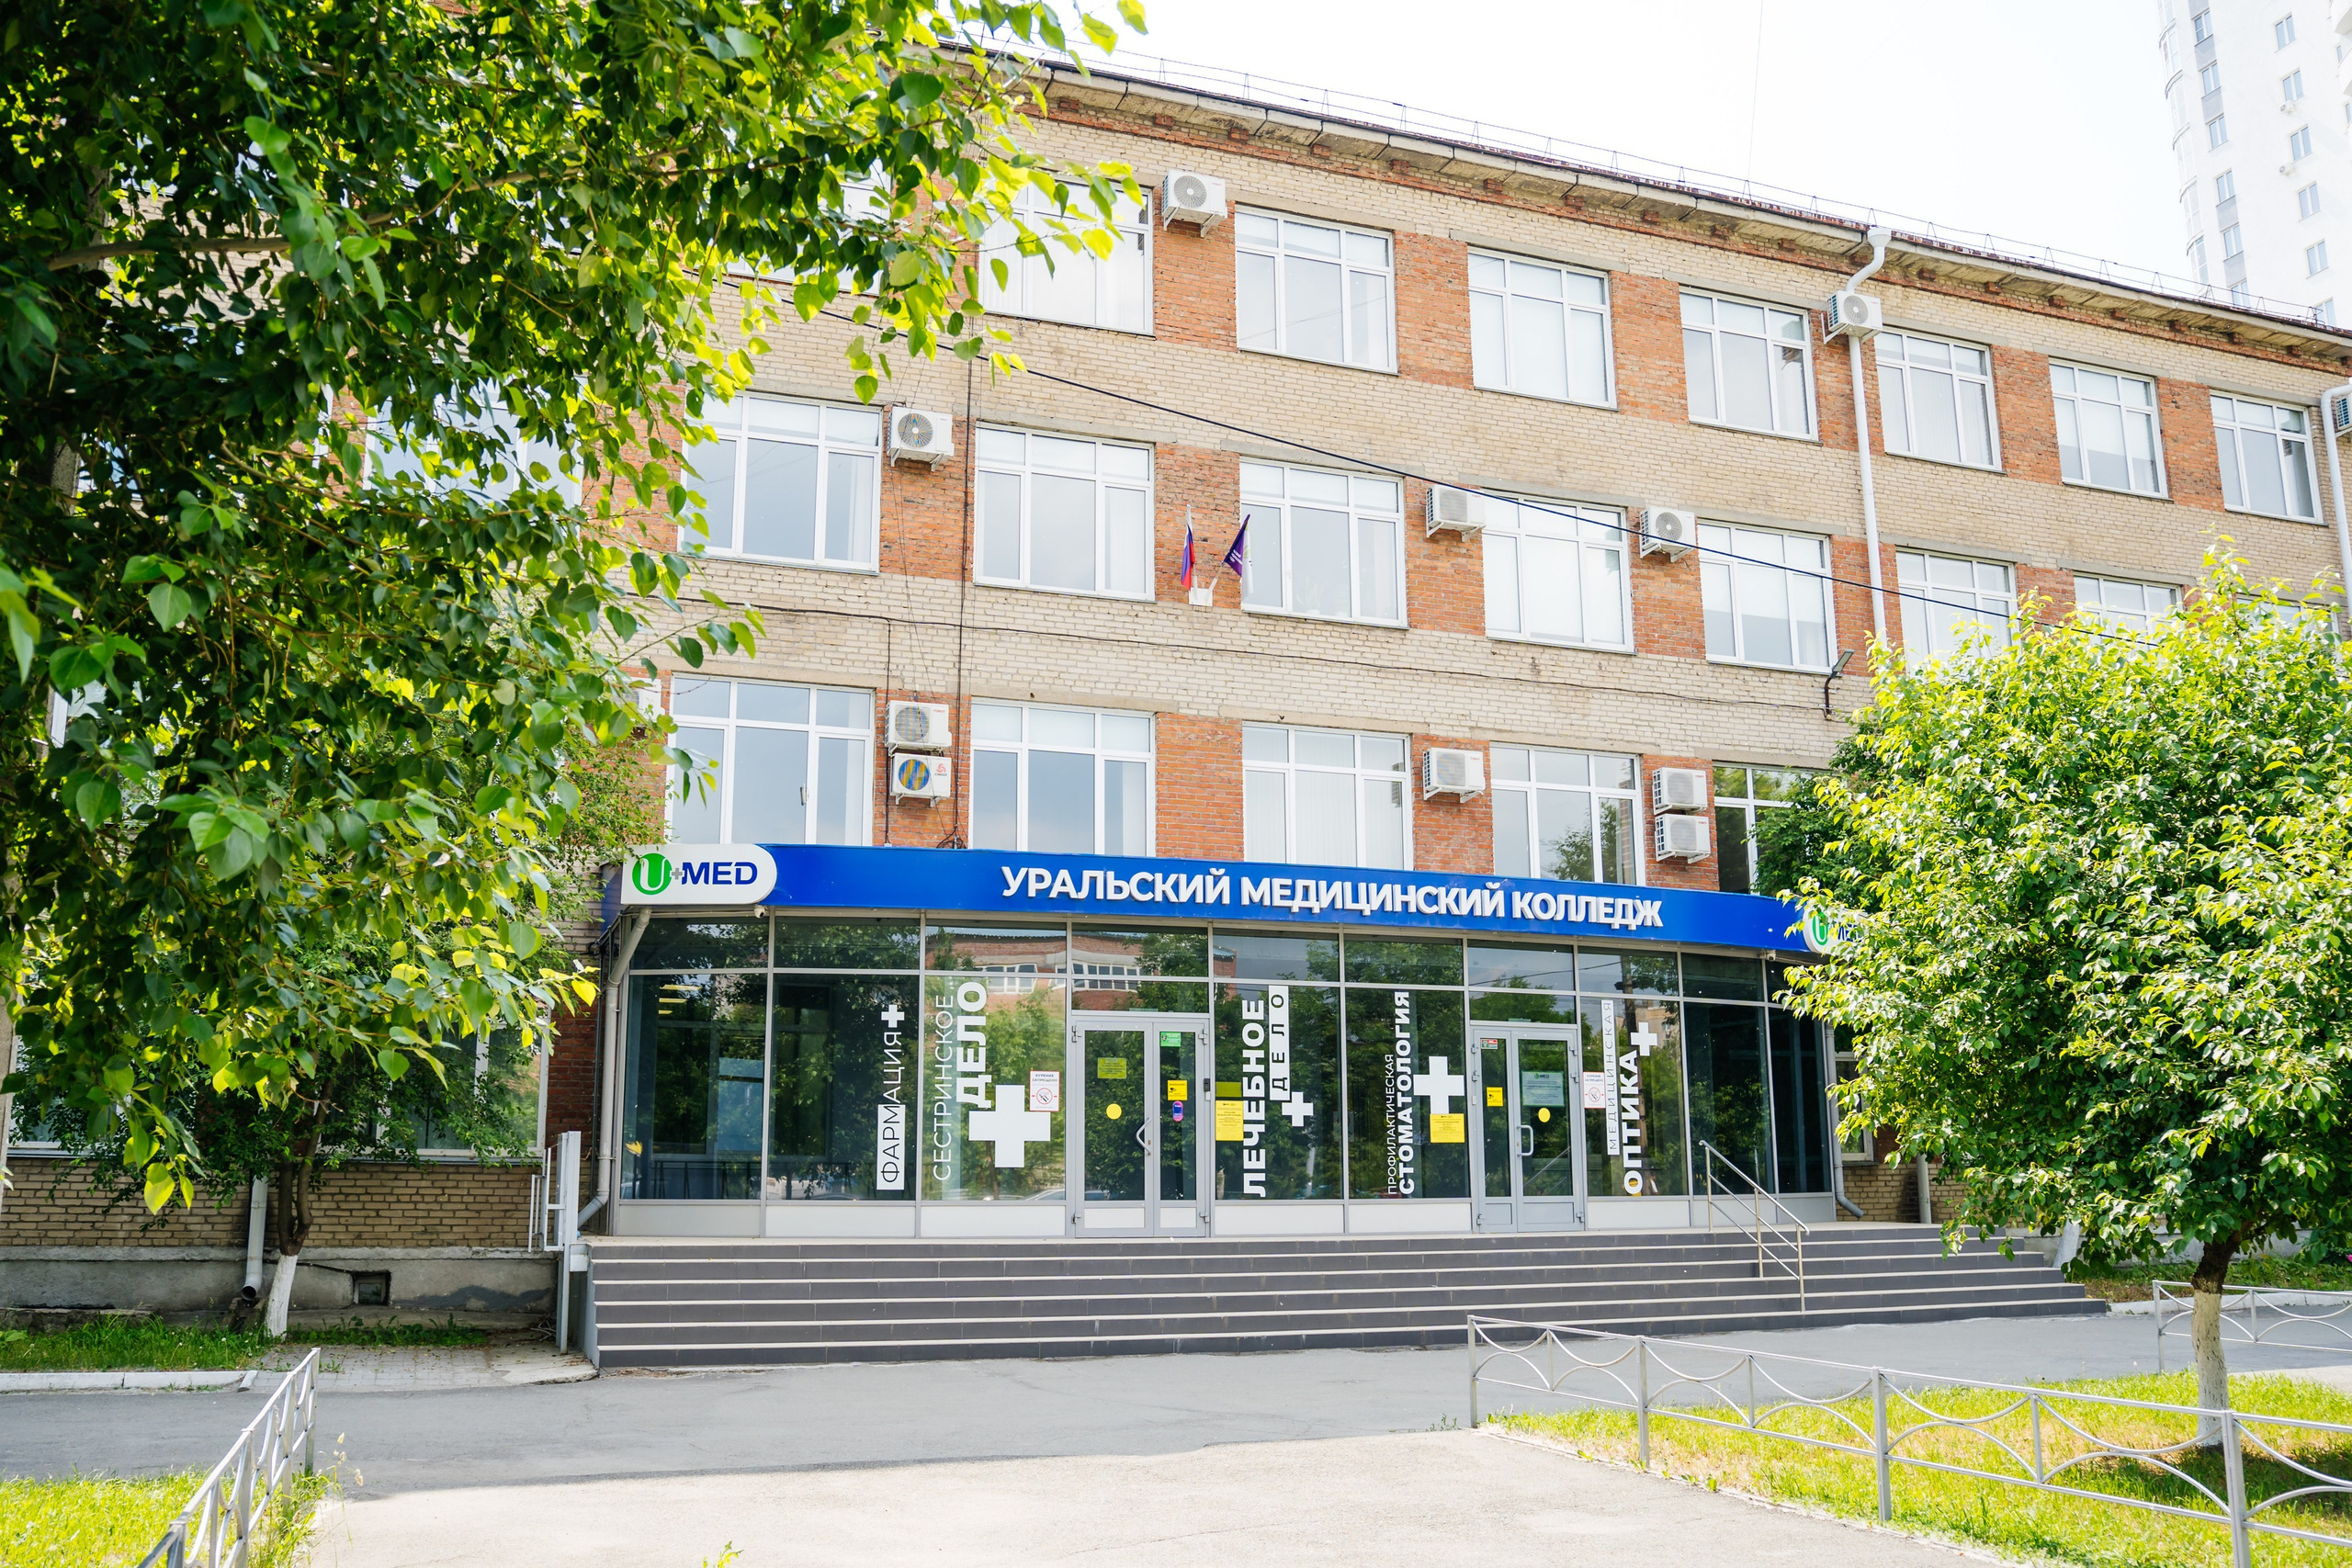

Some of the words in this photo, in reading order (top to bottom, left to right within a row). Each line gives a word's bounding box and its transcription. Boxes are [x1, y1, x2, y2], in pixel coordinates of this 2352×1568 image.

[1001, 866, 1230, 905] УРАЛЬСКИЙ
[1240, 876, 1505, 918] МЕДИЦИНСКИЙ
[1511, 890, 1664, 931] КОЛЛЕДЖ
[880, 1032, 905, 1183] ФАРМАЦИЯ
[933, 995, 954, 1181] СЕСТРИНСКОЕ
[956, 981, 992, 1109] ДЕЛО
[1241, 999, 1266, 1198] ЛЕЧЕБНОЕ
[1271, 994, 1288, 1091] ДЕЛО
[1394, 990, 1415, 1195] СТОМАТОЛОГИЯ
[1603, 1001, 1618, 1150] МЕДИЦИНСКАЯ
[1385, 1054, 1397, 1194] ПРОФИЛАКТИЧЕСКАЯ
[1619, 1049, 1644, 1195] ОПТИКА
